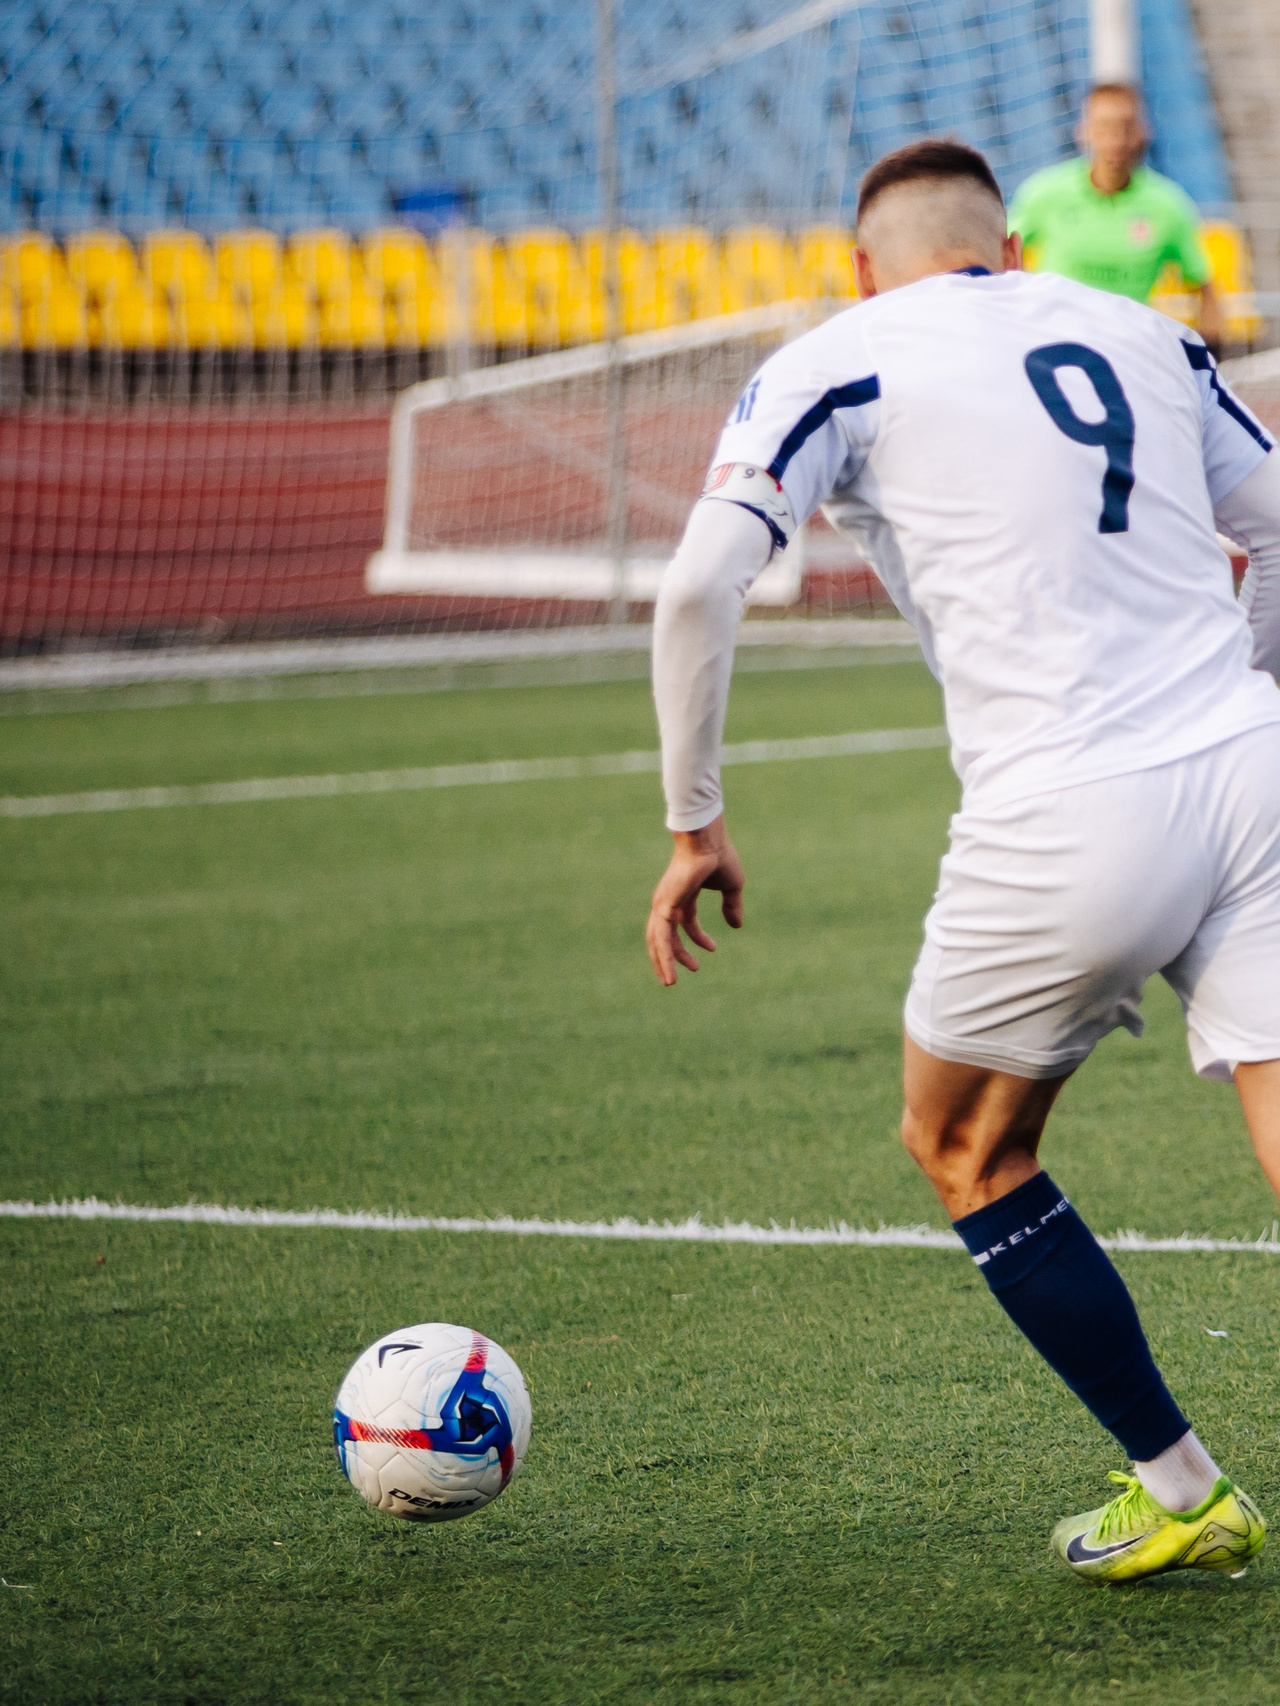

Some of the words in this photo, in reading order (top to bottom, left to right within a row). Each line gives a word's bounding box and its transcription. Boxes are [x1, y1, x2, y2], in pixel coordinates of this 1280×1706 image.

[1024, 341, 1135, 534] 9
[989, 1197, 1068, 1257] KELME
[388, 1487, 482, 1510] DEMIX
